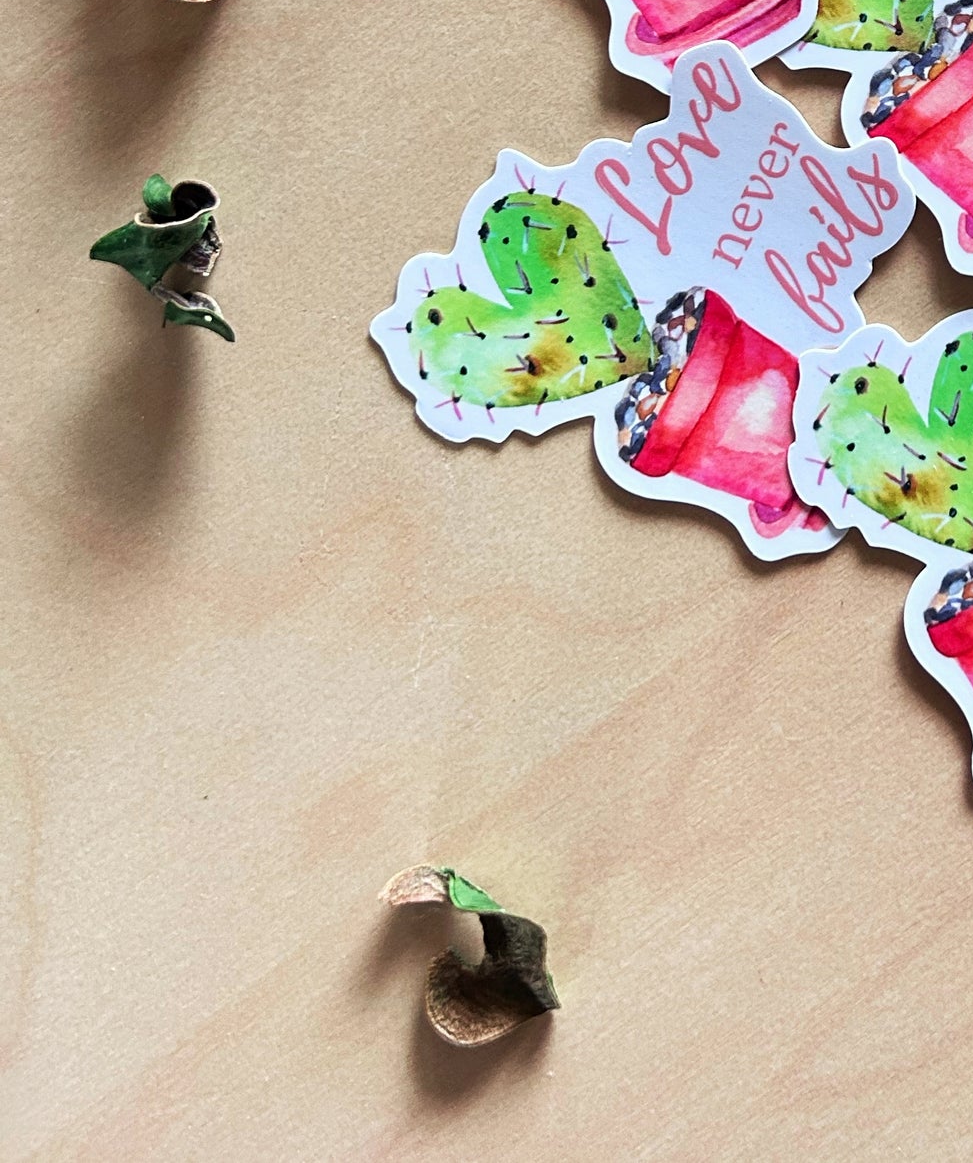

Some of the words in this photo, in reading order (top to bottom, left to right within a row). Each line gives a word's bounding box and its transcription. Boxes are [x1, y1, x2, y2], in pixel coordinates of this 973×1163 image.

[594, 58, 742, 255] Love
[711, 123, 800, 269] never
[765, 154, 899, 334] fails
